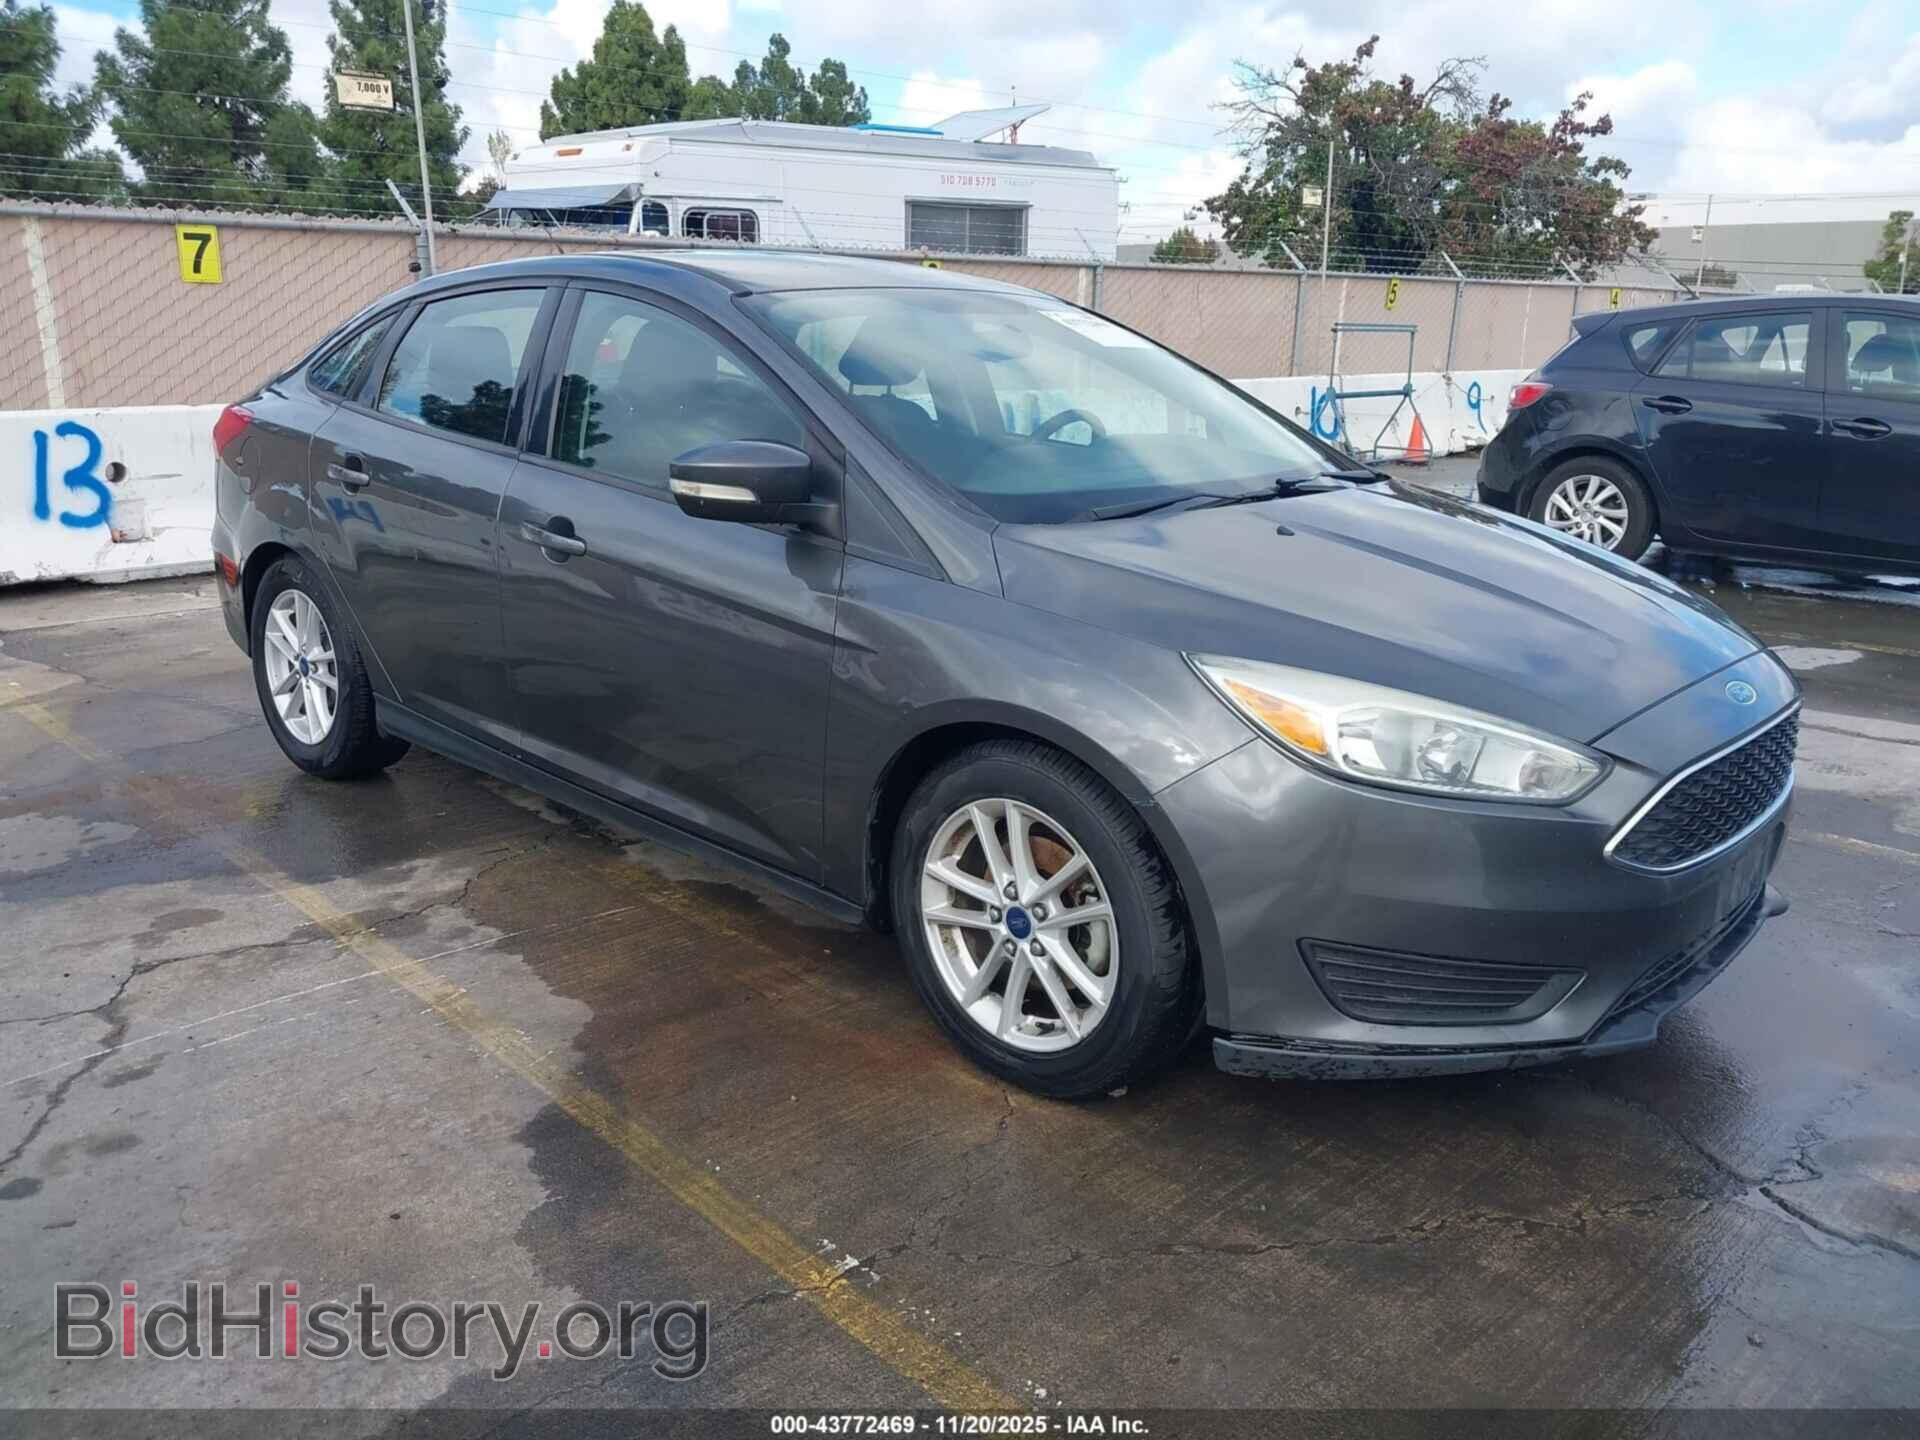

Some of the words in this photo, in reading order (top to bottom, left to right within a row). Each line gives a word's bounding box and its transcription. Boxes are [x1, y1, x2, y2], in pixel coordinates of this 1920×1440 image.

[183, 232, 212, 274] 7
[1389, 282, 1398, 304] 5
[1611, 290, 1618, 309] 4
[1467, 381, 1487, 434] 9
[33, 421, 113, 528] 13
